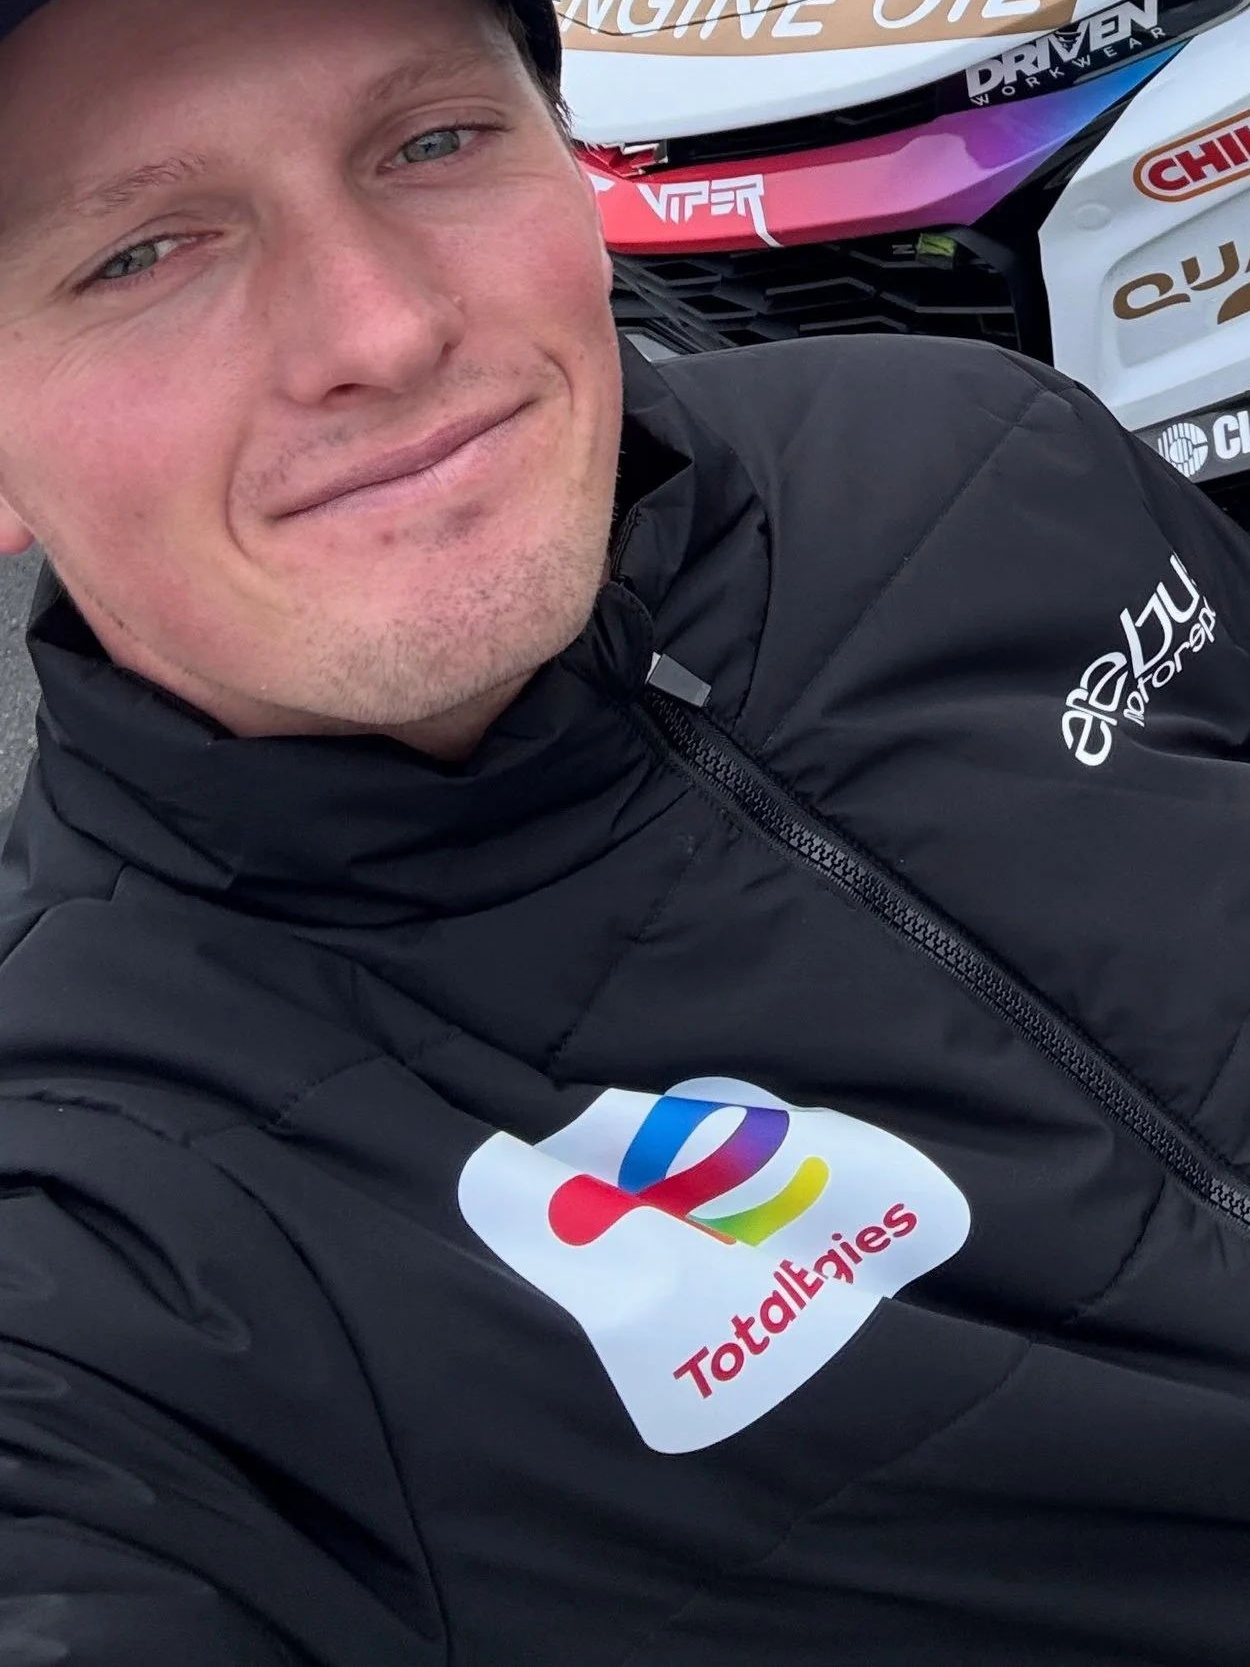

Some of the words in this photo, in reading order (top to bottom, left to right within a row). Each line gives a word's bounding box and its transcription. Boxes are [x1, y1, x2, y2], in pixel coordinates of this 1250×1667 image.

[970, 26, 1167, 108] WORKWEAR
[635, 173, 785, 248] VIPER
[1062, 550, 1200, 766] erebu
